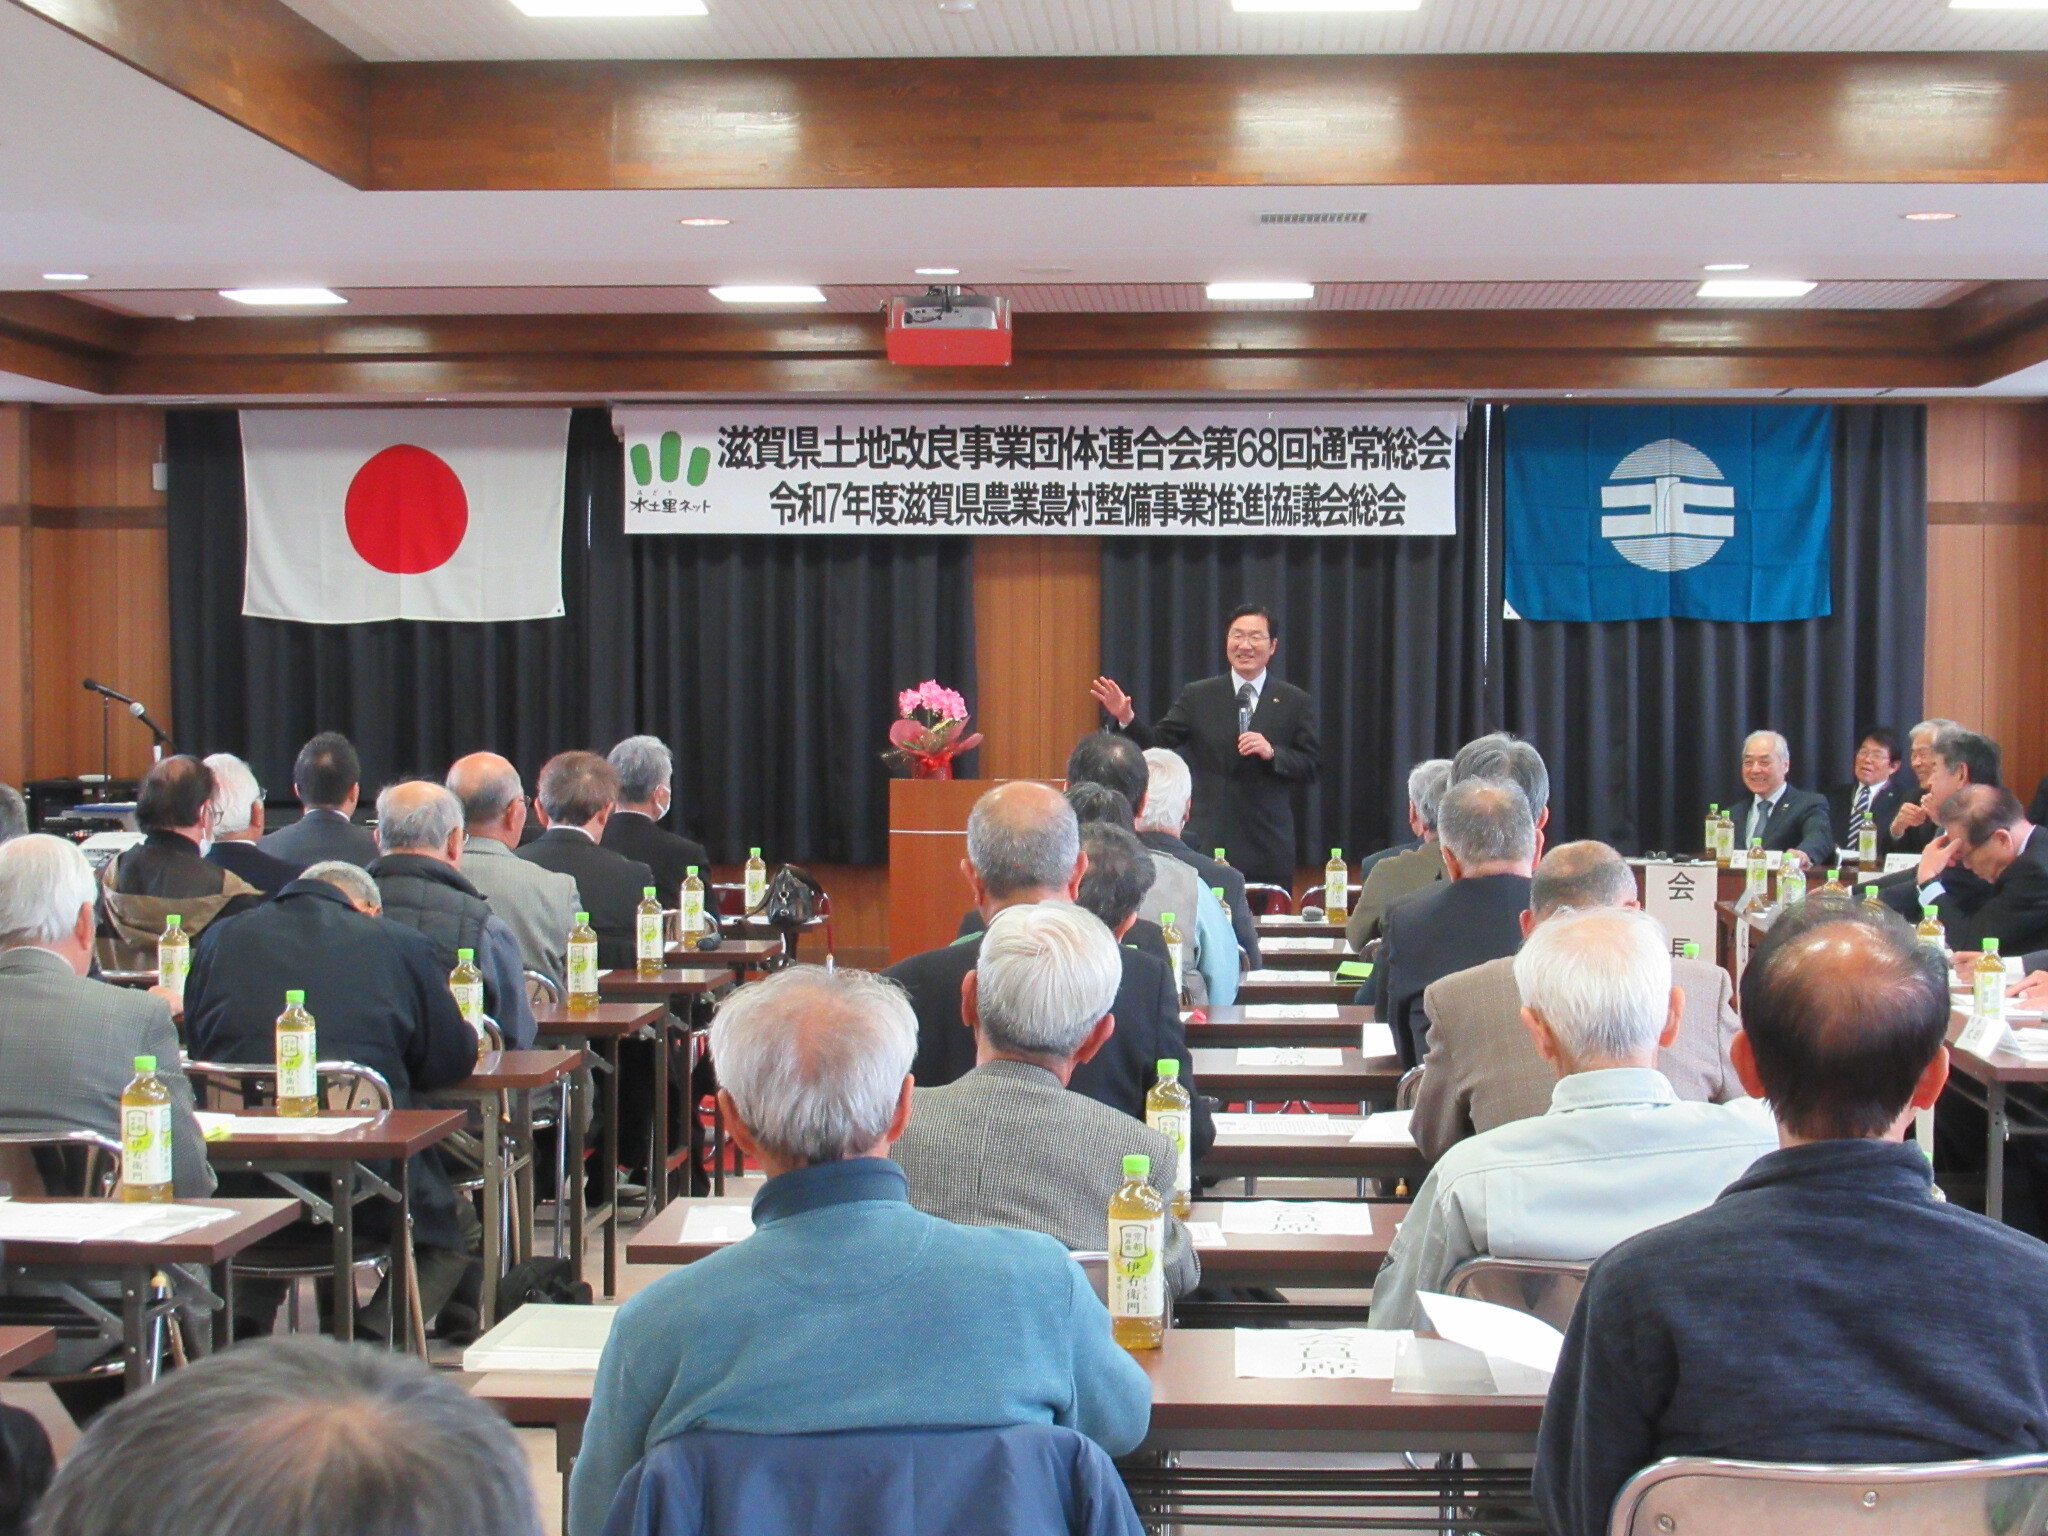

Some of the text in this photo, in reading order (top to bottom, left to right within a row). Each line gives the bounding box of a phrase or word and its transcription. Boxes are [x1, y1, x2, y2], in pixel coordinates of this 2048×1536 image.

[718, 424, 1453, 471] 滋賀県土地改良事業団体連合会第68回通常総会
[629, 497, 711, 514] 水土里ネット
[769, 481, 1406, 528] 令和7年度滋賀県農業農村整備事業推進協議会総会
